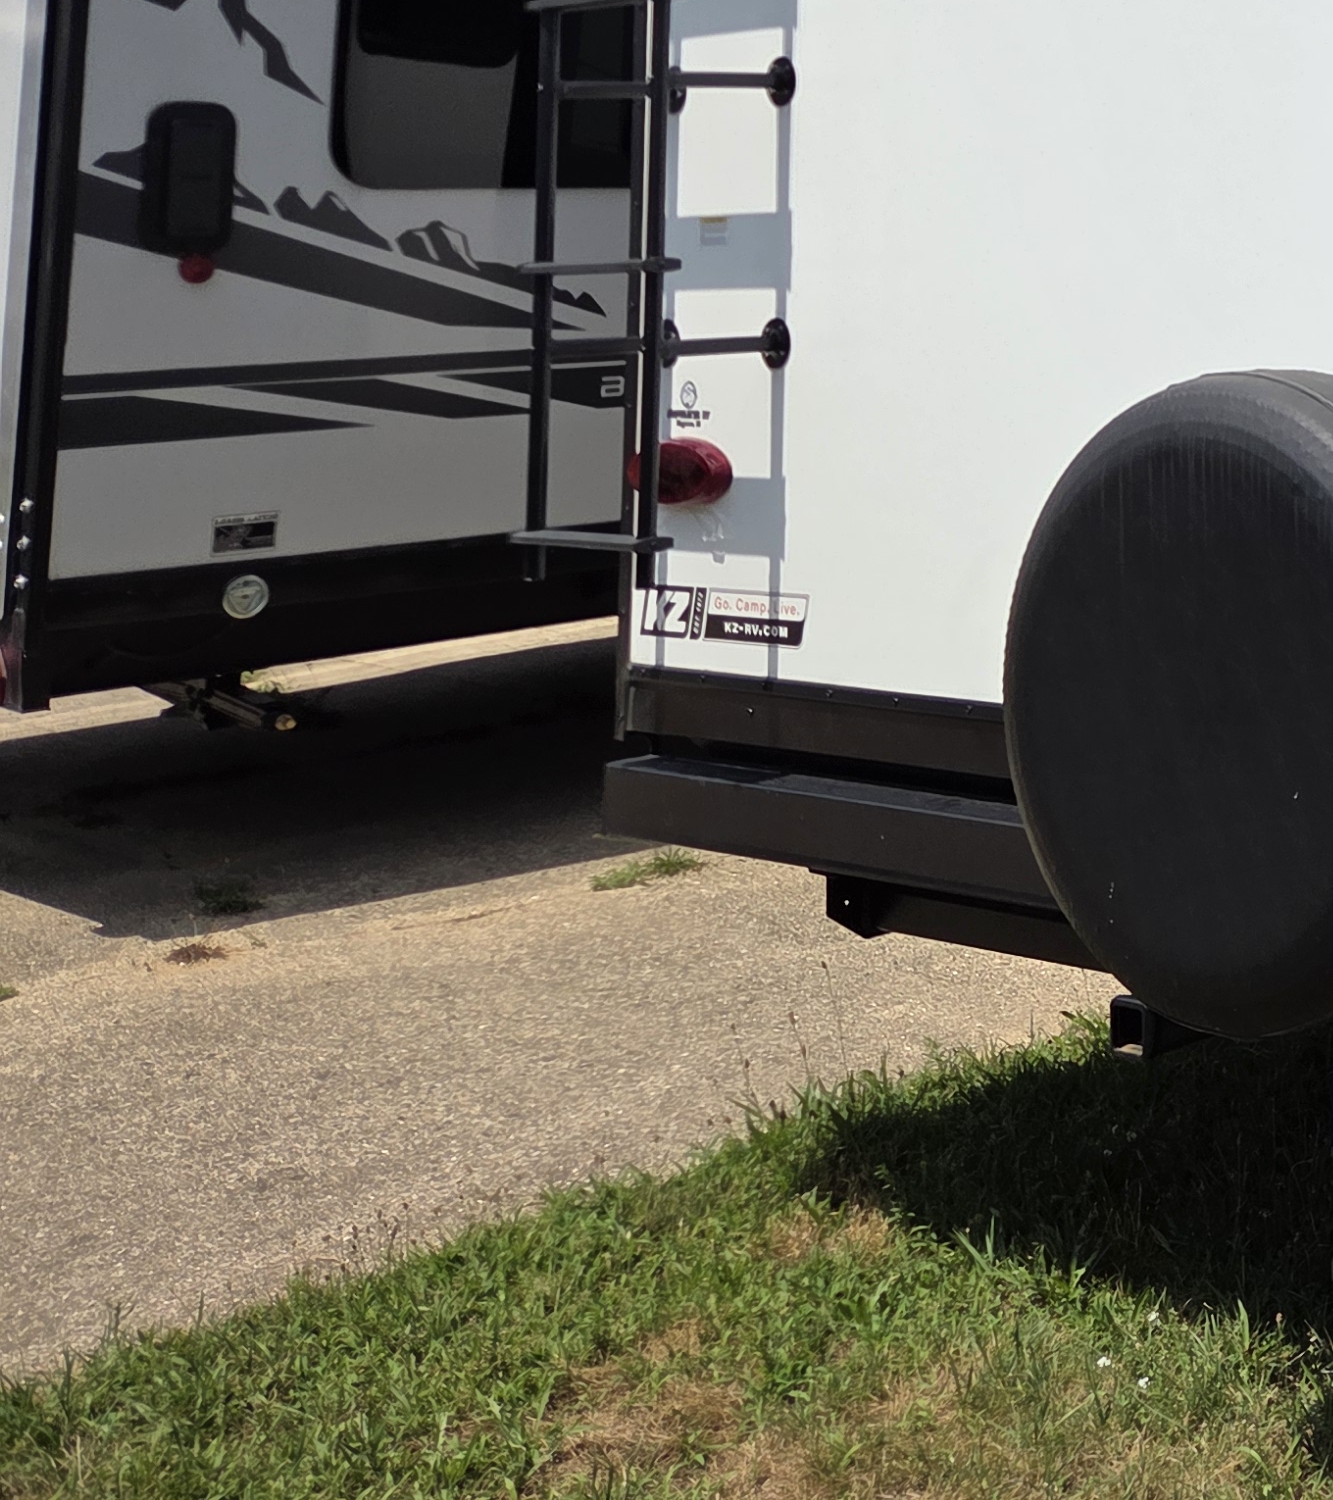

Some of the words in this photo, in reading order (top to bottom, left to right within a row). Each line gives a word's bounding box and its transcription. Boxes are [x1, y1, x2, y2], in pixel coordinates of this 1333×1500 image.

[643, 588, 691, 634] KZ
[713, 596, 732, 611] Go.
[735, 598, 770, 616] Camp.
[723, 621, 789, 639] KZ-RV.COM
